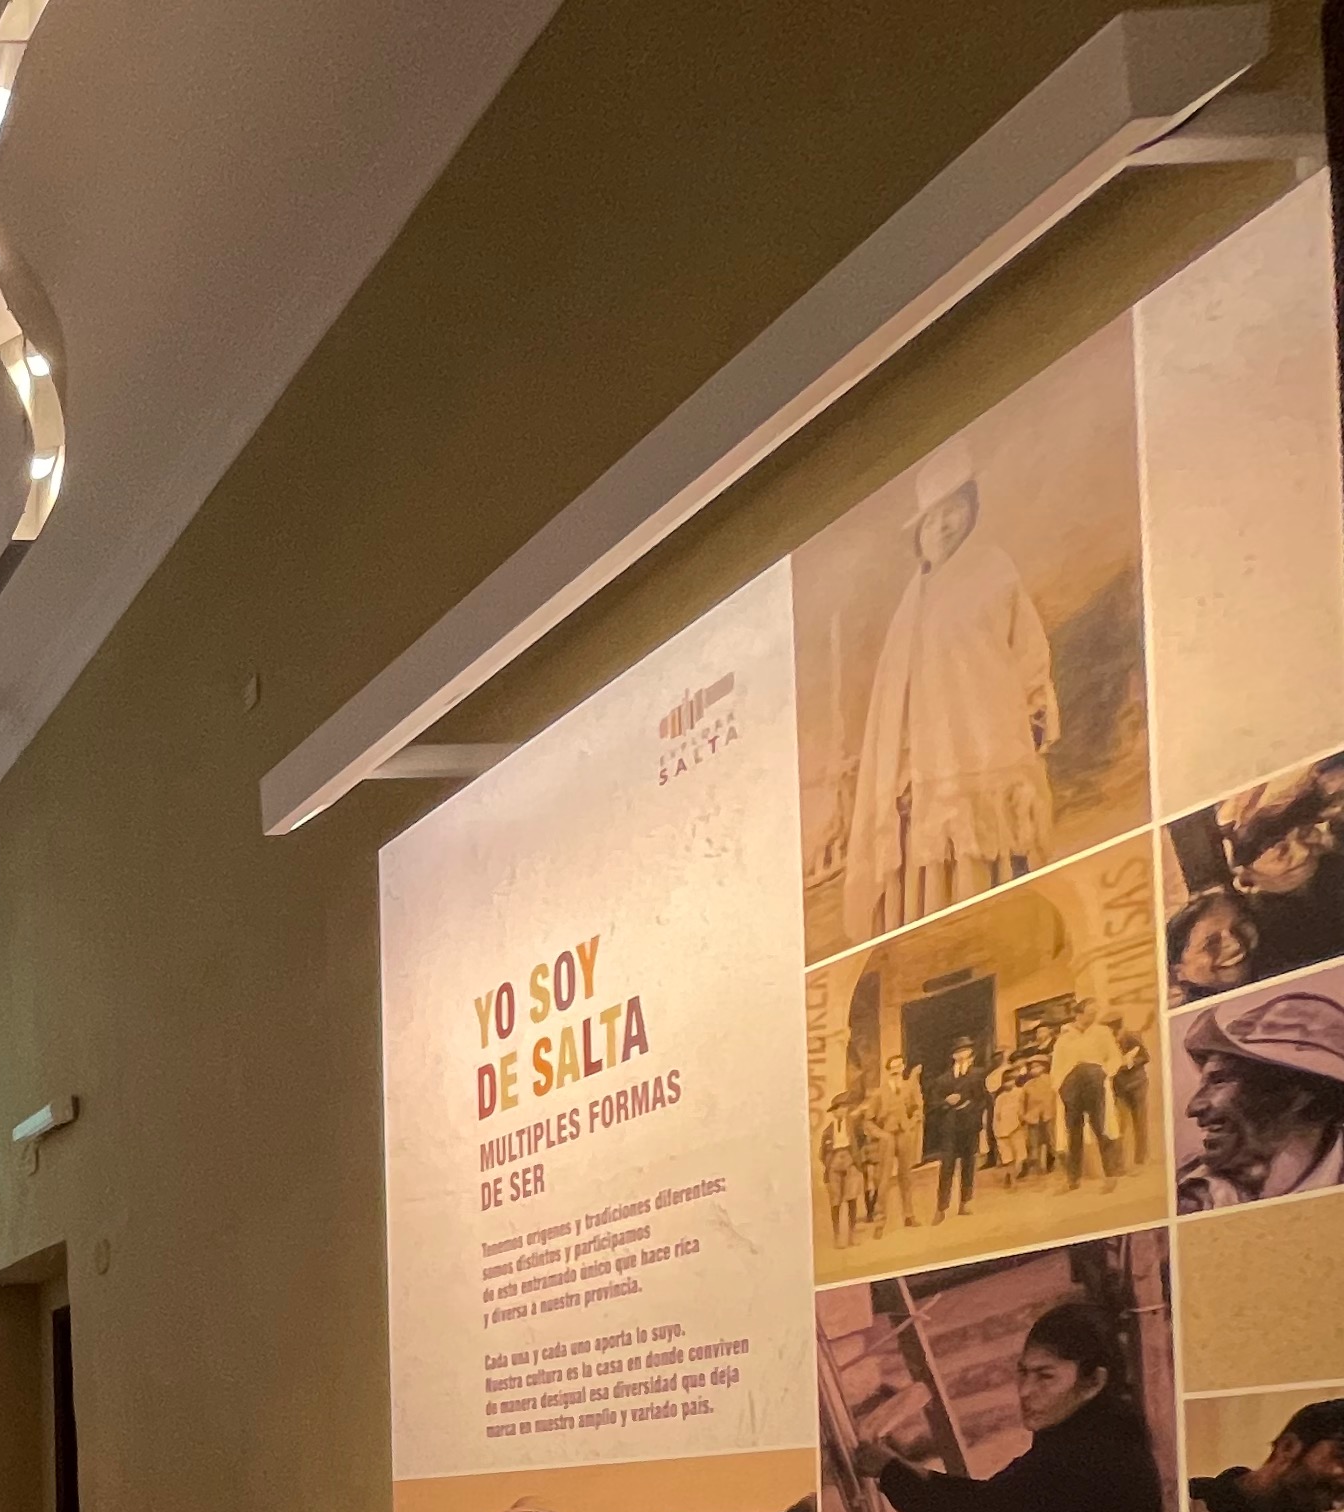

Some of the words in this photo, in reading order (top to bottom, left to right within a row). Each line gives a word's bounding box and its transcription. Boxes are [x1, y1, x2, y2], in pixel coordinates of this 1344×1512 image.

[659, 726, 738, 786] SALTA
[474, 982, 515, 1049] YO
[529, 934, 601, 1024] SOY
[478, 1051, 519, 1121] DE
[532, 995, 649, 1097] SALTA
[480, 1108, 580, 1172] MULTIPLES
[589, 1069, 681, 1133] FORMAS
[481, 1177, 503, 1211] DE
[510, 1163, 545, 1201] SER
[574, 1219, 581, 1236] y
[585, 1198, 651, 1230] tradiciones
[483, 1288, 494, 1303] de
[497, 1283, 517, 1299] este
[521, 1267, 577, 1294] entramado
[615, 1254, 637, 1276] que
[641, 1245, 671, 1266] hace
[674, 1237, 700, 1258] rica
[516, 1249, 561, 1272] distintos
[564, 1246, 571, 1264] y
[574, 1224, 651, 1262] participamos
[483, 1313, 489, 1330] y
[492, 1305, 528, 1324] diversa
[531, 1302, 537, 1316] a
[540, 1292, 581, 1313] nuestra
[584, 1276, 643, 1308] provincia.
[484, 1353, 508, 1371] Cada
[511, 1351, 530, 1366] una
[533, 1349, 539, 1366] y
[542, 1341, 567, 1360] cada
[570, 1340, 591, 1356] uno
[594, 1329, 632, 1355] aporta
[636, 1326, 648, 1344] lo
[652, 1323, 686, 1343] suyo.
[485, 1374, 523, 1393] Nuestra
[525, 1368, 563, 1387] cultura
[566, 1366, 579, 1381] es
[582, 1361, 592, 1378] la
[595, 1359, 623, 1376] casa
[627, 1355, 642, 1372] en
[645, 1346, 684, 1369] donde
[688, 1338, 749, 1362] conviven
[485, 1400, 498, 1416] de
[500, 1397, 537, 1414] manera
[540, 1386, 586, 1410] desigual
[589, 1386, 609, 1402] esa
[613, 1372, 677, 1399] diversidad
[682, 1373, 706, 1394] que
[710, 1365, 740, 1389] deja
[486, 1423, 516, 1438] marca
[519, 1421, 532, 1434] en
[535, 1414, 575, 1433] nuestro
[578, 1408, 617, 1431] amplio
[620, 1409, 628, 1428] y
[631, 1400, 678, 1422] variado
